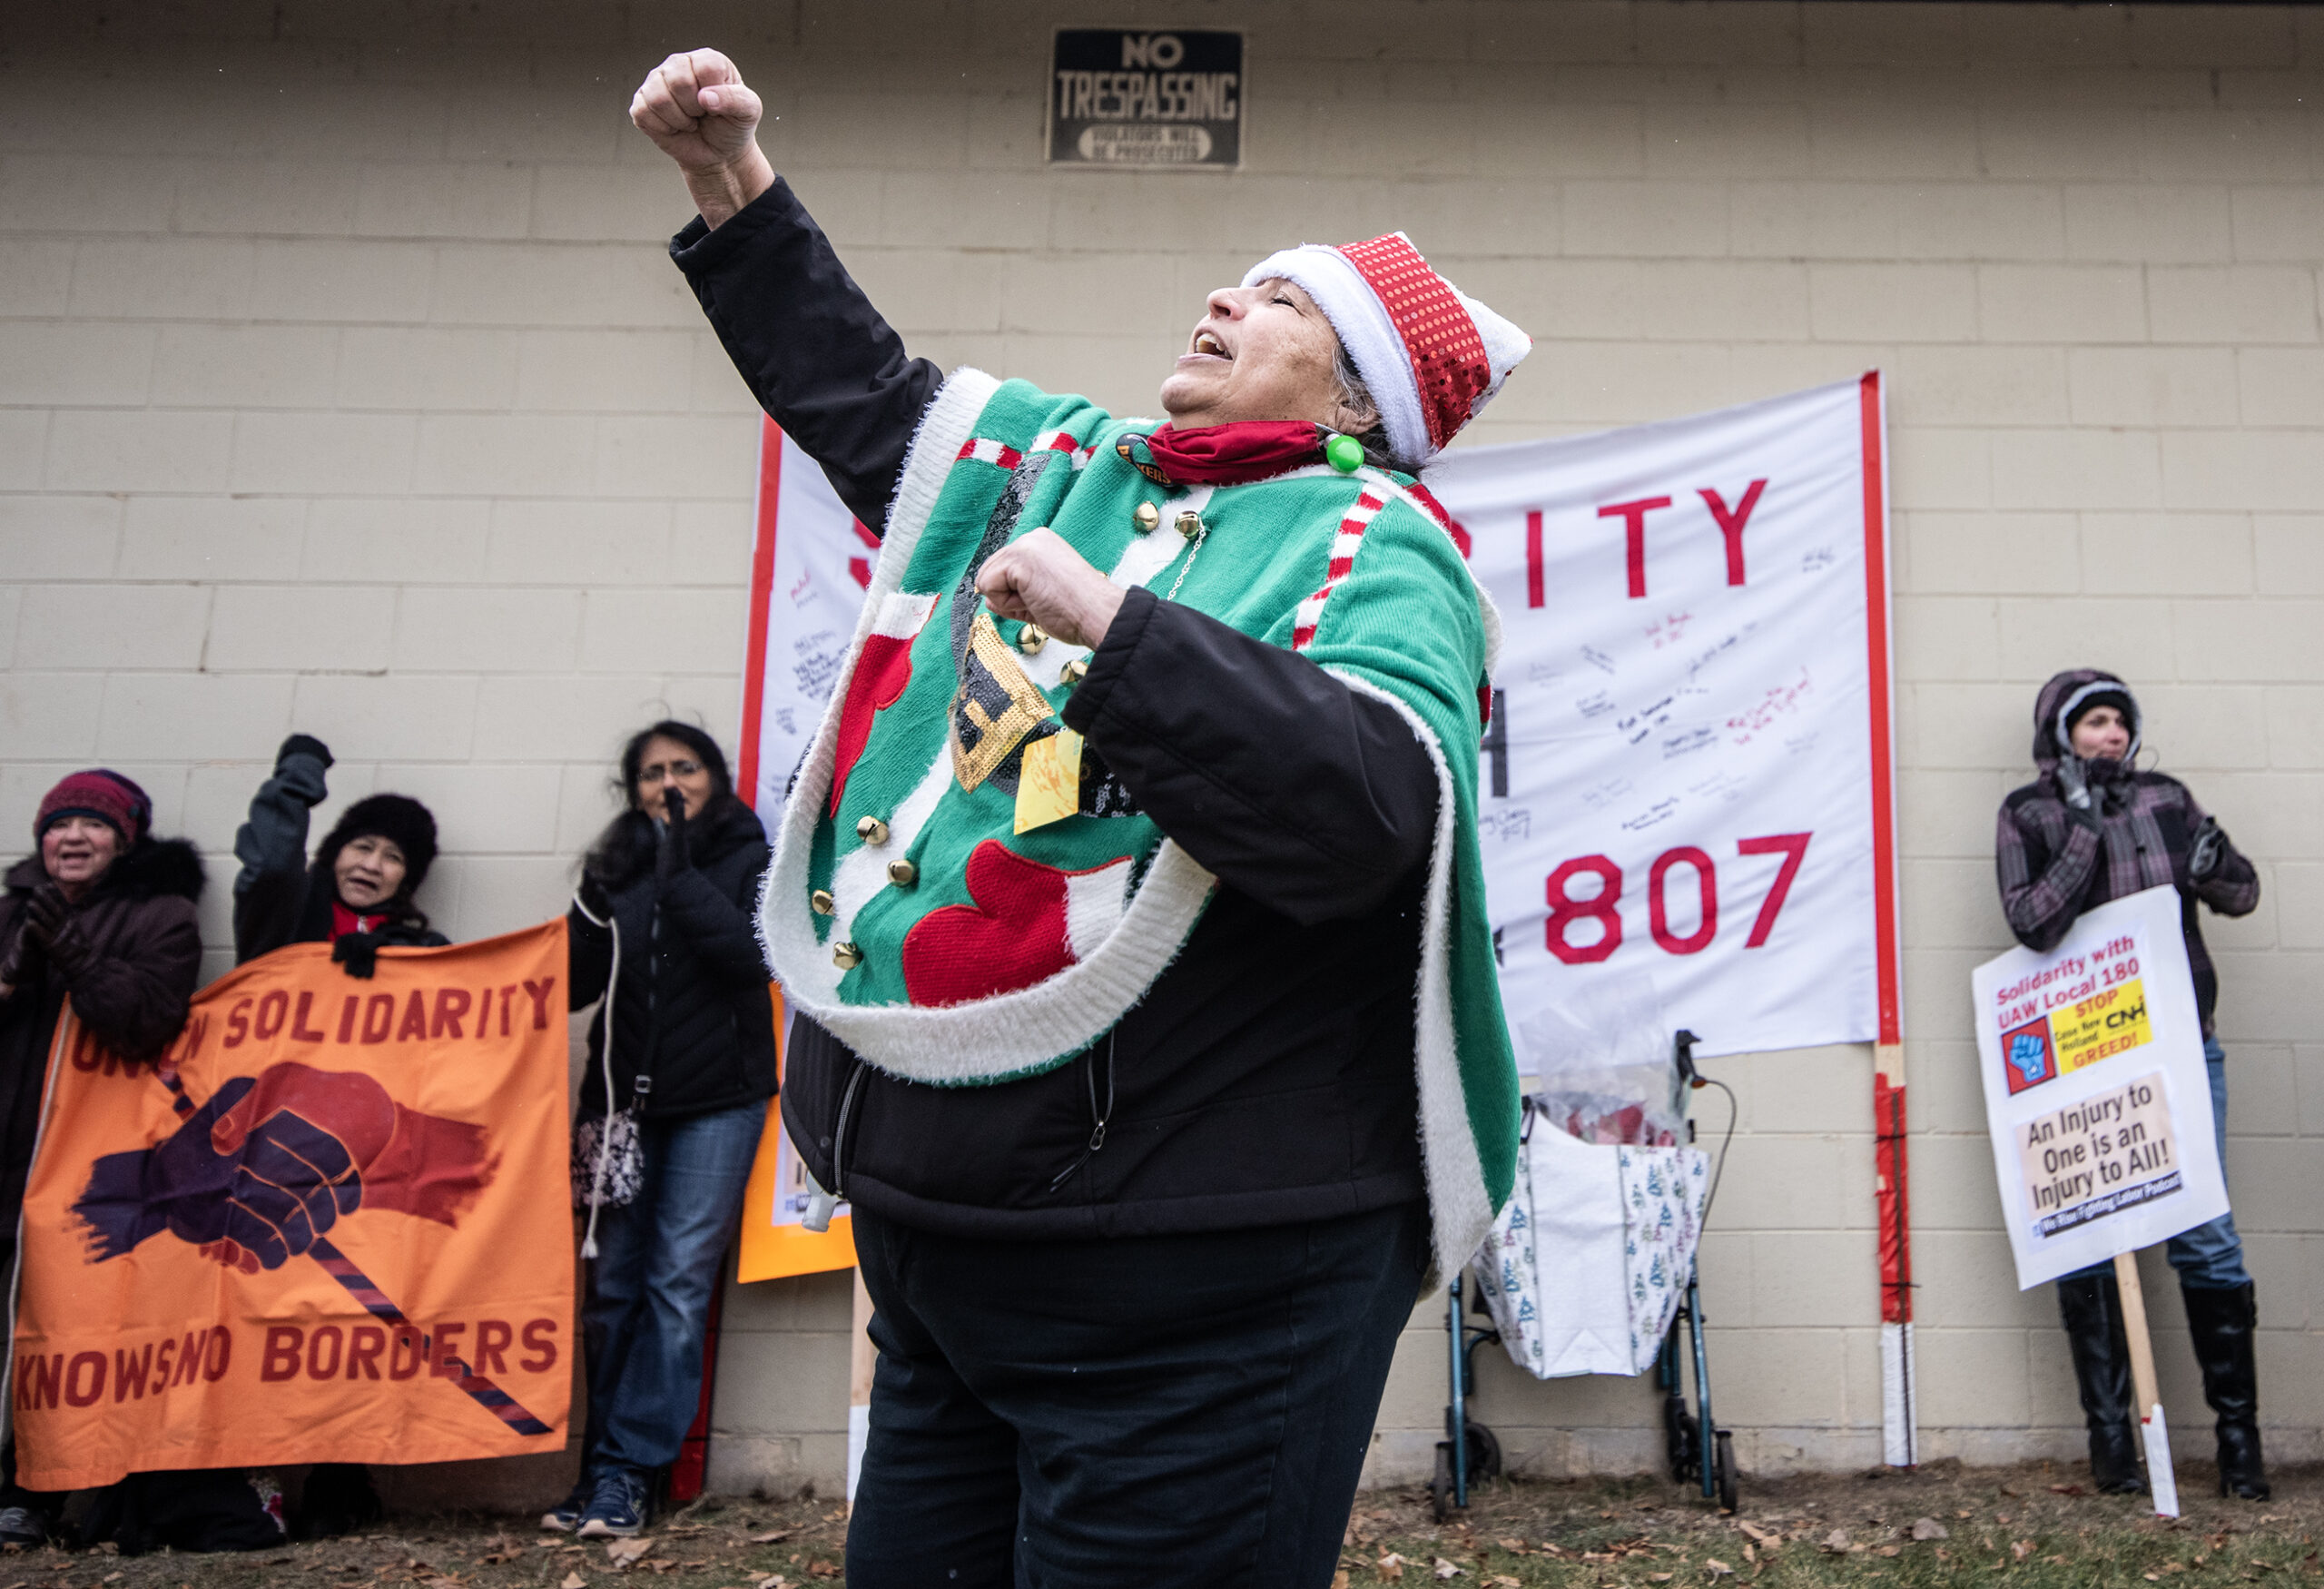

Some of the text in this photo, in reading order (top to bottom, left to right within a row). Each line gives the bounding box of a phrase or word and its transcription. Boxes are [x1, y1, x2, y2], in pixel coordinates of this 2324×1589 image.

[1122, 34, 1184, 69] NO
[1057, 70, 1236, 120] TRESPASSING
[1544, 832, 1814, 964] 807
[1997, 936, 2134, 1006] Solidarity with
[1998, 957, 2140, 1029] UAW Local 180
[2074, 989, 2118, 1019] STOP
[222, 976, 556, 1049] SOLIDARITY
[2073, 1031, 2138, 1068] GREED!
[2028, 1084, 2152, 1149] An Injury to
[2043, 1120, 2146, 1174] One is an
[2032, 1138, 2169, 1209] Injury to All!
[16, 1318, 559, 1412] KNOWS NO BORDERS
